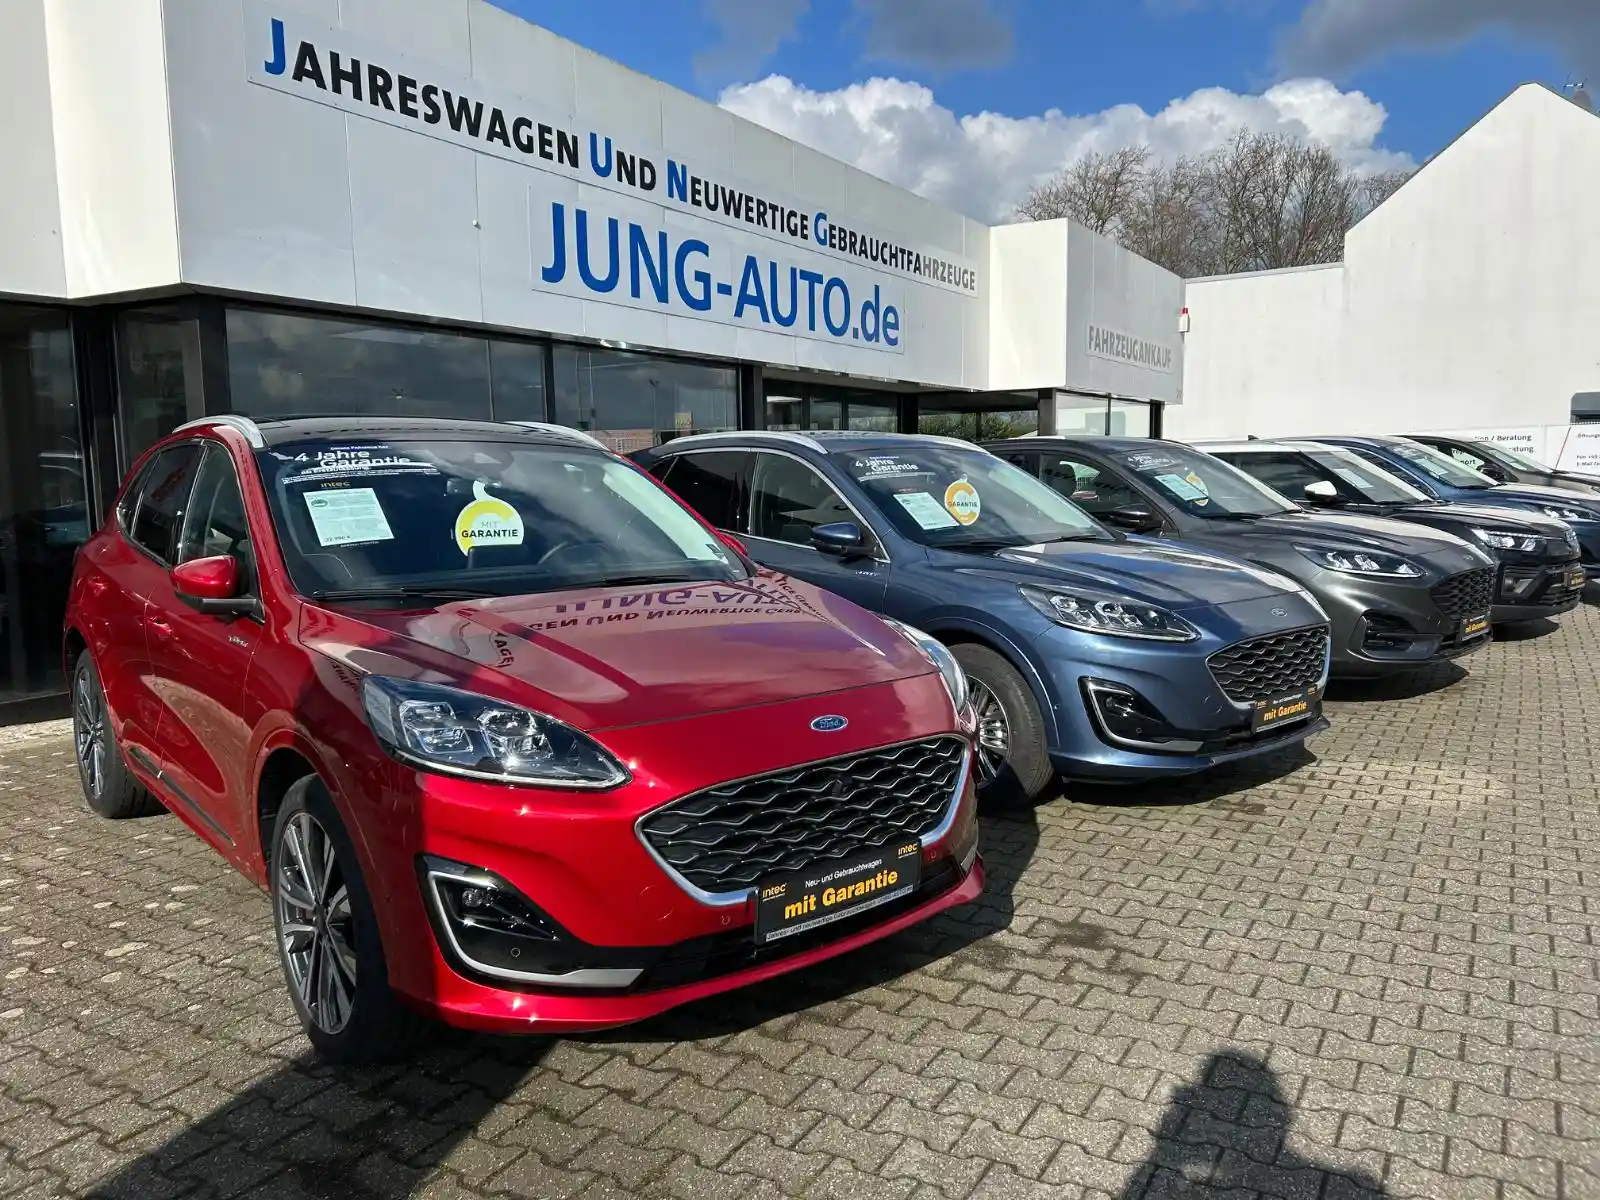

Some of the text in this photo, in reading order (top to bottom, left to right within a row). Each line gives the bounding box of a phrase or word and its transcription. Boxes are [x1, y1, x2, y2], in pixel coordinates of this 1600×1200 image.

[264, 18, 976, 291] JAHRESWAGEN UND NEUWERTIGE GEBRAUCHTFAHRZEUGE
[541, 202, 900, 346] JUNG-AUTO.de
[1088, 325, 1172, 369] FAHRZEUGANKAUF
[1497, 434, 1532, 442] Beratung
[295, 450, 370, 462] 4 Jahre
[320, 456, 411, 468] Garantie
[481, 521, 499, 529] MIT
[461, 529, 519, 538] GARANTIE
[1278, 700, 1307, 717] Garantie
[898, 843, 918, 855] intec
[805, 858, 882, 888] Neu- und Gebrauchtwagen
[763, 883, 787, 898] intec
[784, 894, 817, 920] mit
[822, 870, 898, 906] Garantie
